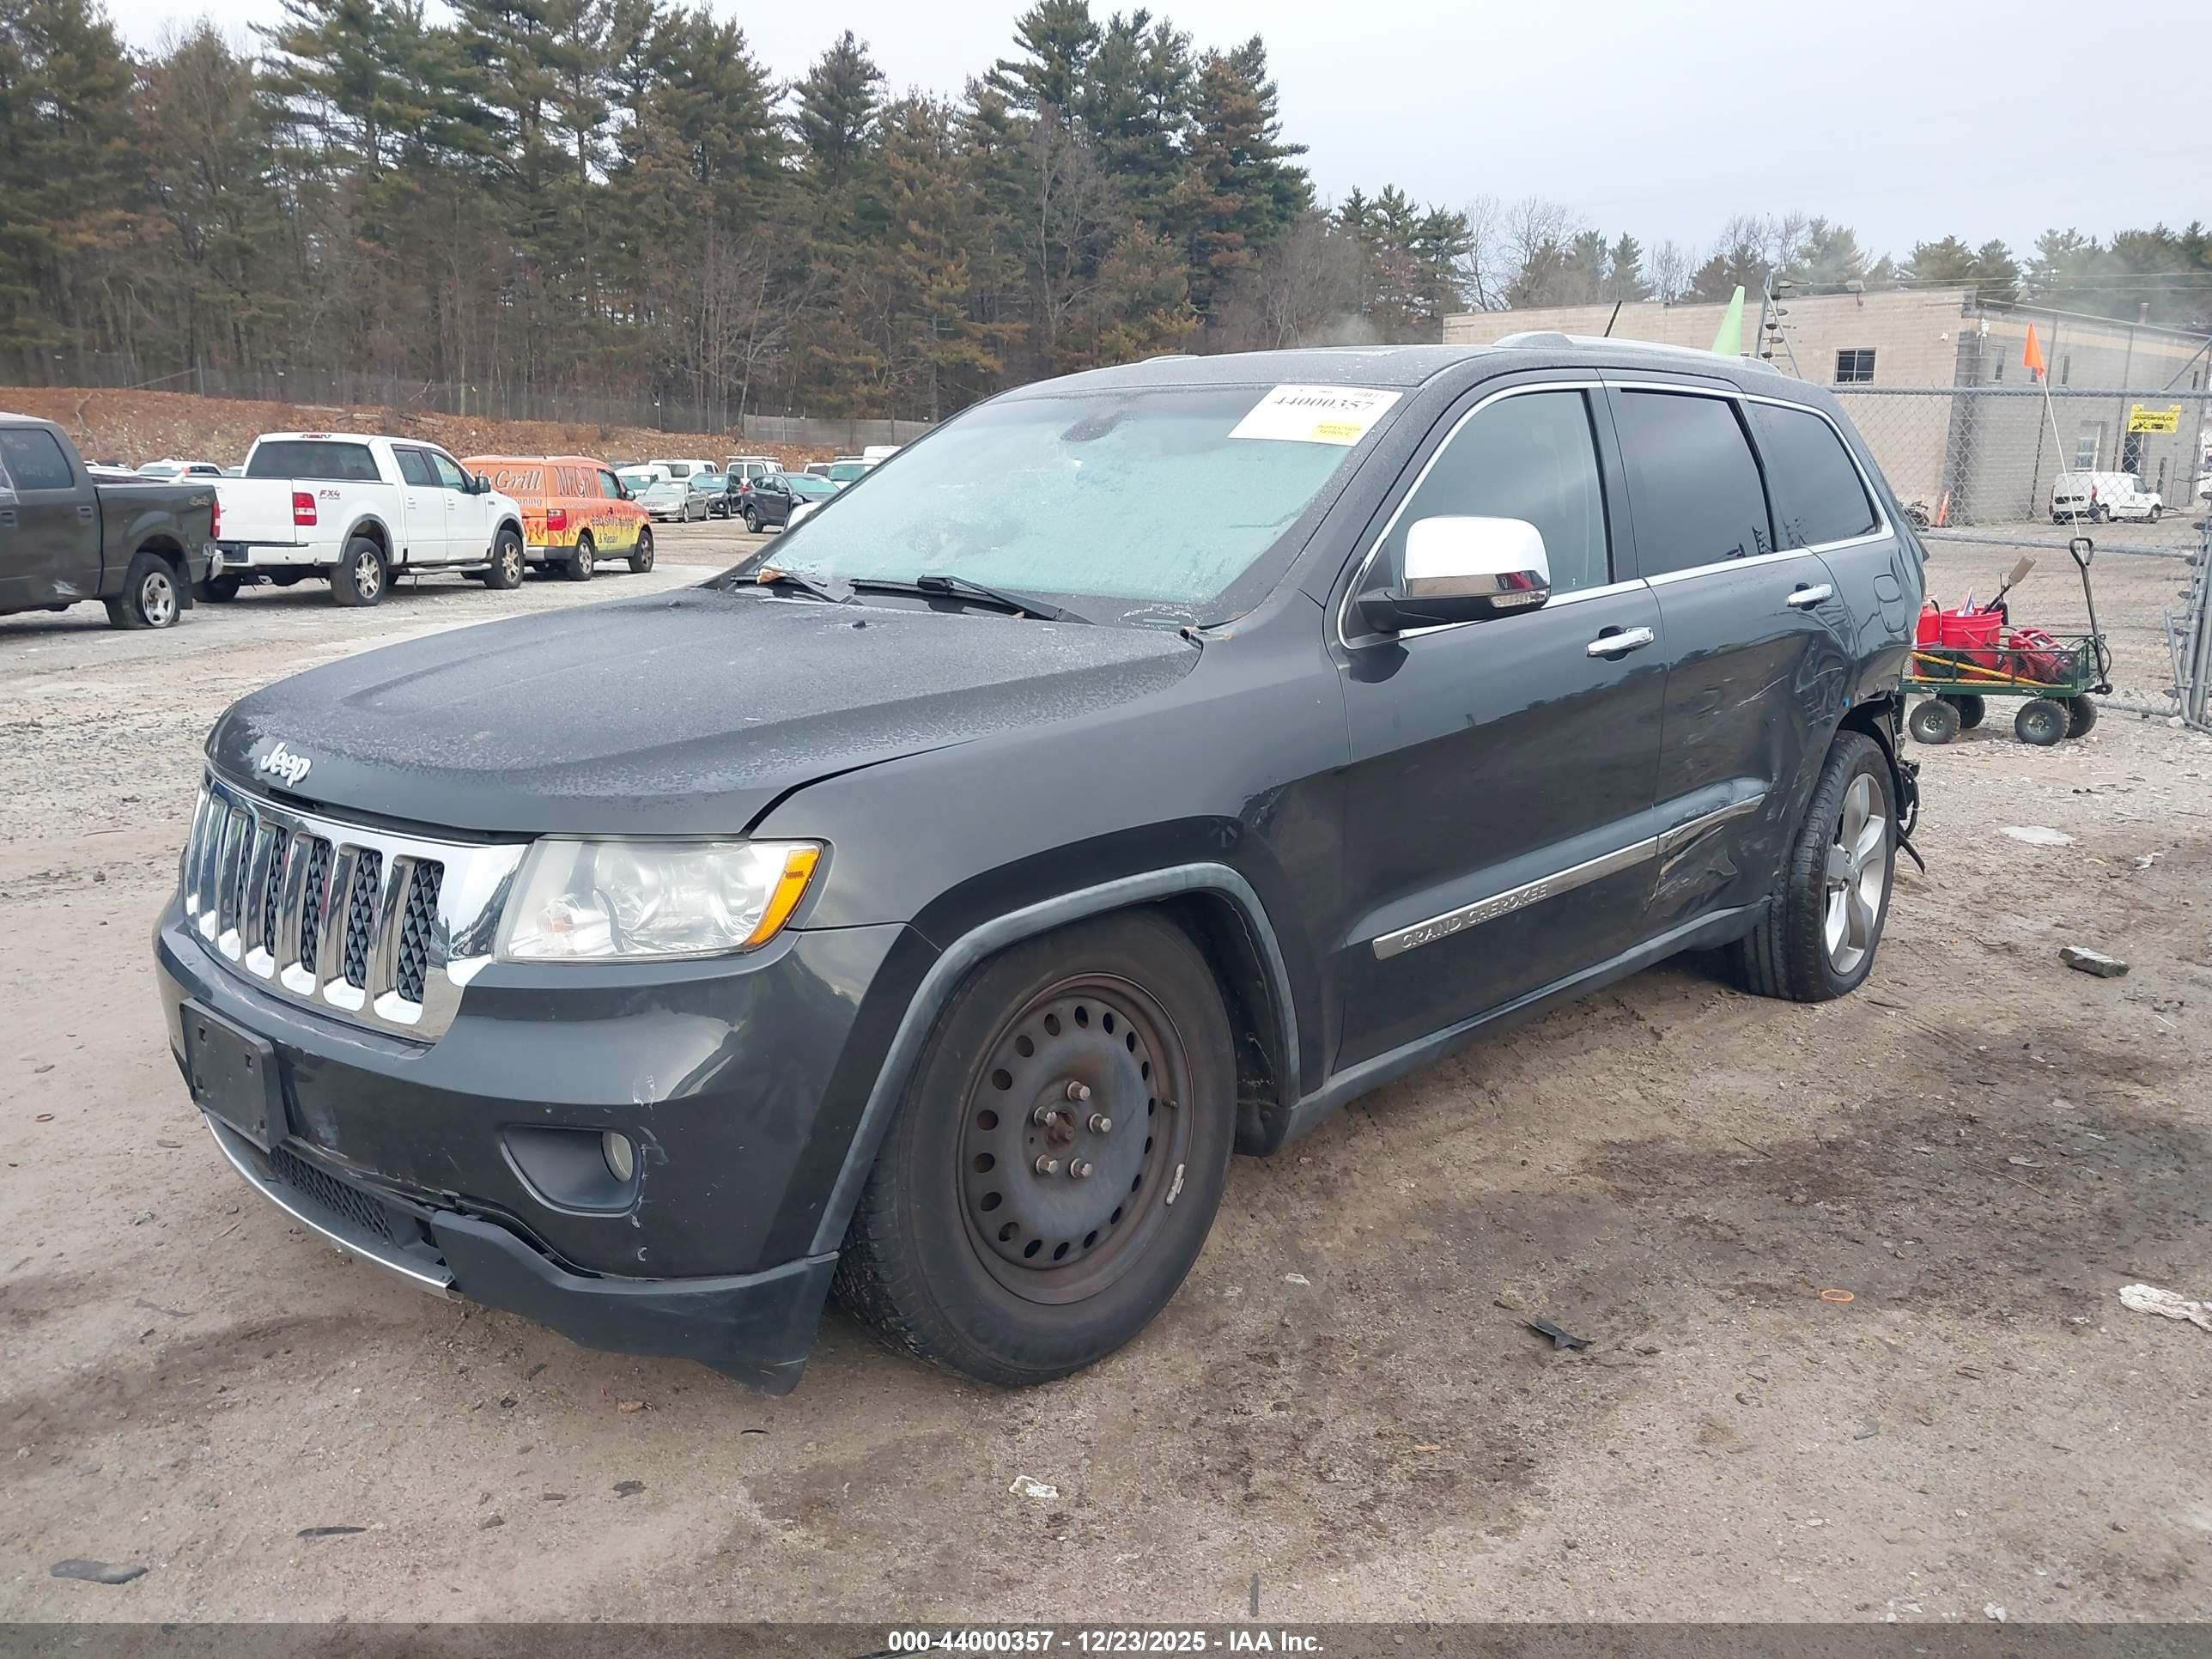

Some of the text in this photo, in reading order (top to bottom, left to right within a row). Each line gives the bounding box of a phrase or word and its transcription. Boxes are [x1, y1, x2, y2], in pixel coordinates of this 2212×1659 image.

[1273, 397, 1374, 410] 44000357
[495, 469, 543, 492] Grill
[259, 742, 313, 788] Jeep
[1400, 884, 1548, 950] GRAND CHEROKEE
